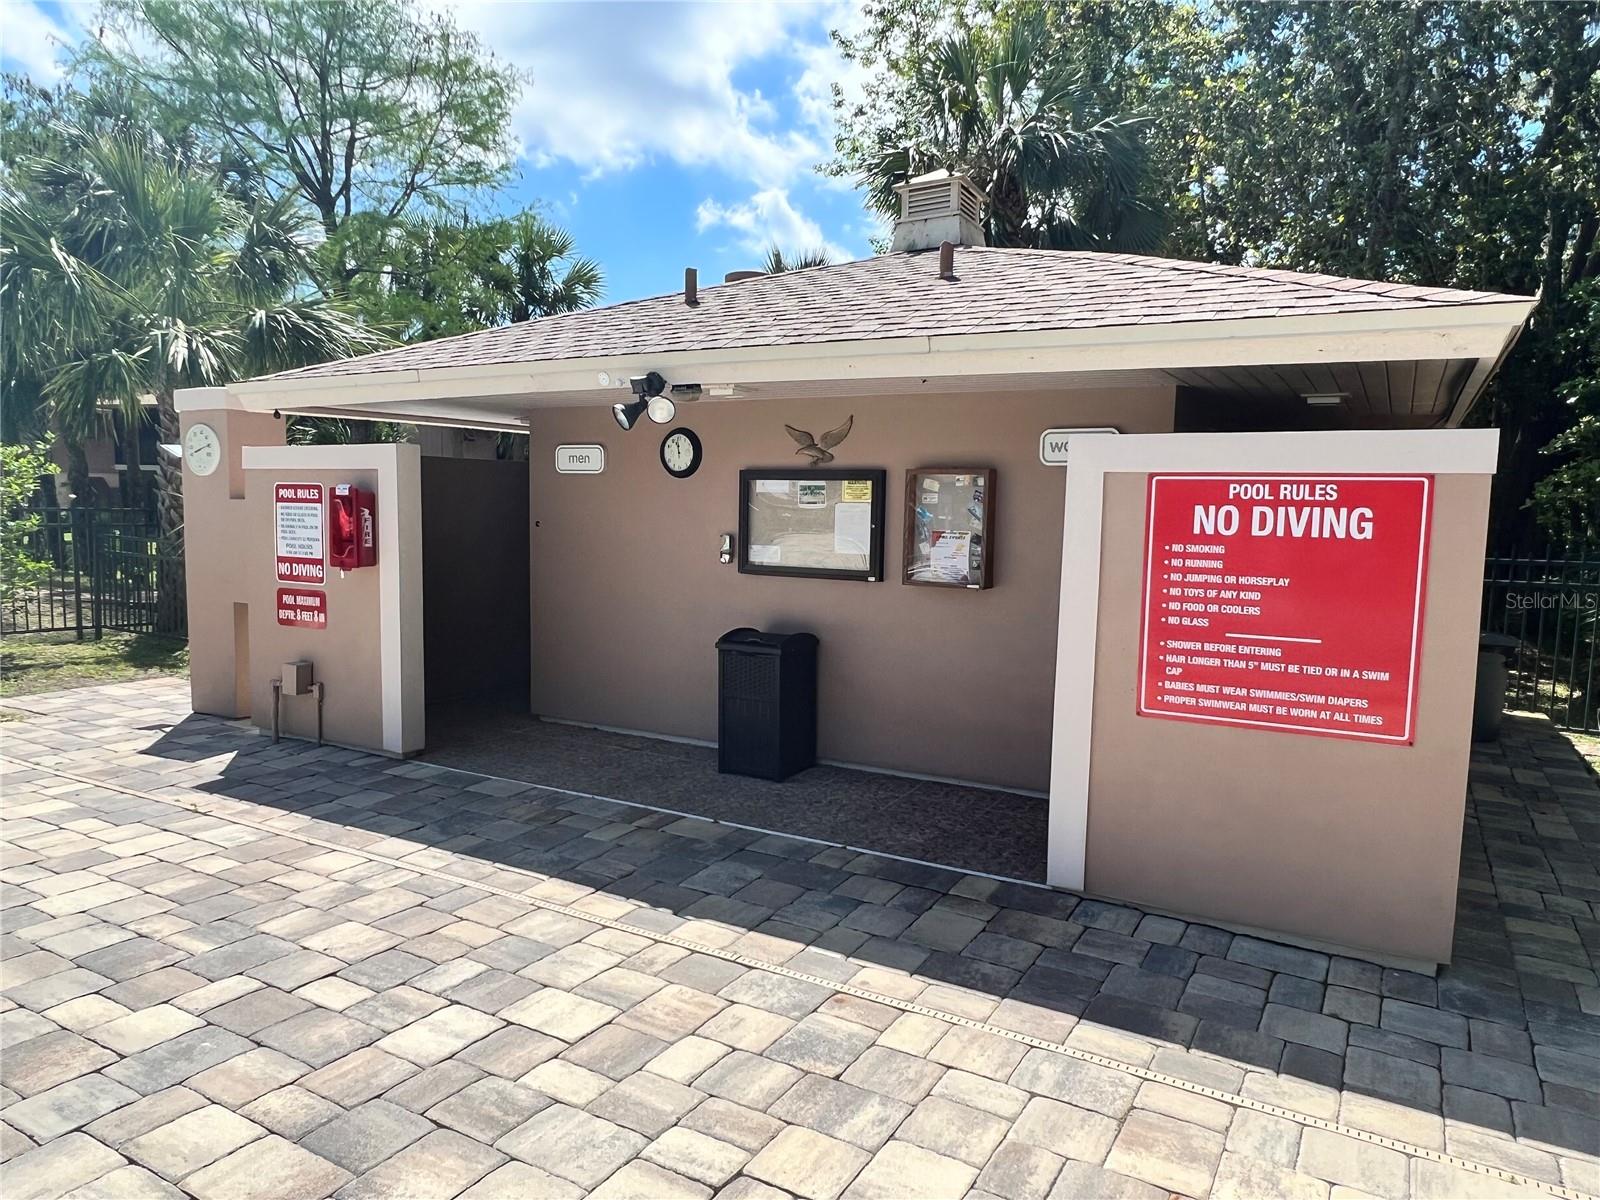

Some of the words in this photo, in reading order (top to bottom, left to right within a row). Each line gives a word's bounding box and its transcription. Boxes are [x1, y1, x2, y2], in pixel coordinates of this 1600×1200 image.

[568, 454, 590, 464] men
[278, 488, 296, 498] POOL
[297, 489, 319, 499] RULES
[1229, 484, 1274, 500] POOL
[1279, 484, 1338, 502] RULES
[1192, 504, 1240, 536] NO
[1250, 506, 1374, 540] DIVING
[1172, 544, 1184, 552] NO
[1185, 544, 1225, 554] SMOKING
[278, 562, 290, 574] NO
[293, 563, 322, 577] DIVING
[1171, 559, 1183, 567] NO
[1185, 559, 1223, 569] RUNNING
[1170, 573, 1183, 581] NO
[1184, 574, 1222, 584] JUMPING
[1224, 575, 1237, 584] OR
[1238, 576, 1290, 587] HORSEPLAY
[282, 594, 295, 604] POOL
[1169, 587, 1181, 596] NO
[1184, 588, 1204, 597] TOYS
[1206, 589, 1218, 598] OF
[1219, 590, 1238, 599] ANY
[1239, 591, 1261, 600] KIND
[1168, 602, 1181, 610] NO
[1182, 602, 1204, 612] FOOD
[1206, 604, 1219, 612] OR
[1221, 605, 1261, 615] COOLERS
[297, 609, 301, 620] 8
[302, 611, 313, 621] FEET
[314, 610, 318, 622] 8
[1168, 616, 1180, 625] NO
[1181, 617, 1209, 626] GLASS
[1166, 640, 1201, 651] SHOWER
[1203, 642, 1237, 653] BEFORE
[1238, 645, 1282, 657] ENTERING
[1166, 654, 1186, 664] HAIR
[1187, 656, 1220, 667] LONGER
[1223, 659, 1246, 669] THAN
[1260, 662, 1285, 672] MUST
[1288, 664, 1300, 674] BE
[1302, 665, 1322, 676] TIED
[1325, 668, 1338, 677] OR
[1340, 669, 1350, 678] IN
[1352, 670, 1360, 679] A
[1362, 671, 1390, 681] SWIM
[1166, 667, 1183, 676] CAP
[1164, 681, 1195, 691] BABIES
[1196, 684, 1220, 694] MUST
[1222, 686, 1247, 697] WEAR
[1249, 689, 1326, 704] SWIMMIES/SWIM
[1328, 696, 1369, 708] DIAPERS
[1164, 695, 1196, 706] PROPER
[1198, 698, 1247, 711] SWIMWEAR
[1249, 703, 1274, 714] MUST
[1276, 706, 1288, 716] BE
[1290, 708, 1317, 719] WORN
[1319, 711, 1331, 720] AT
[1333, 712, 1351, 722] ALL
[1353, 714, 1383, 726] TIMES
